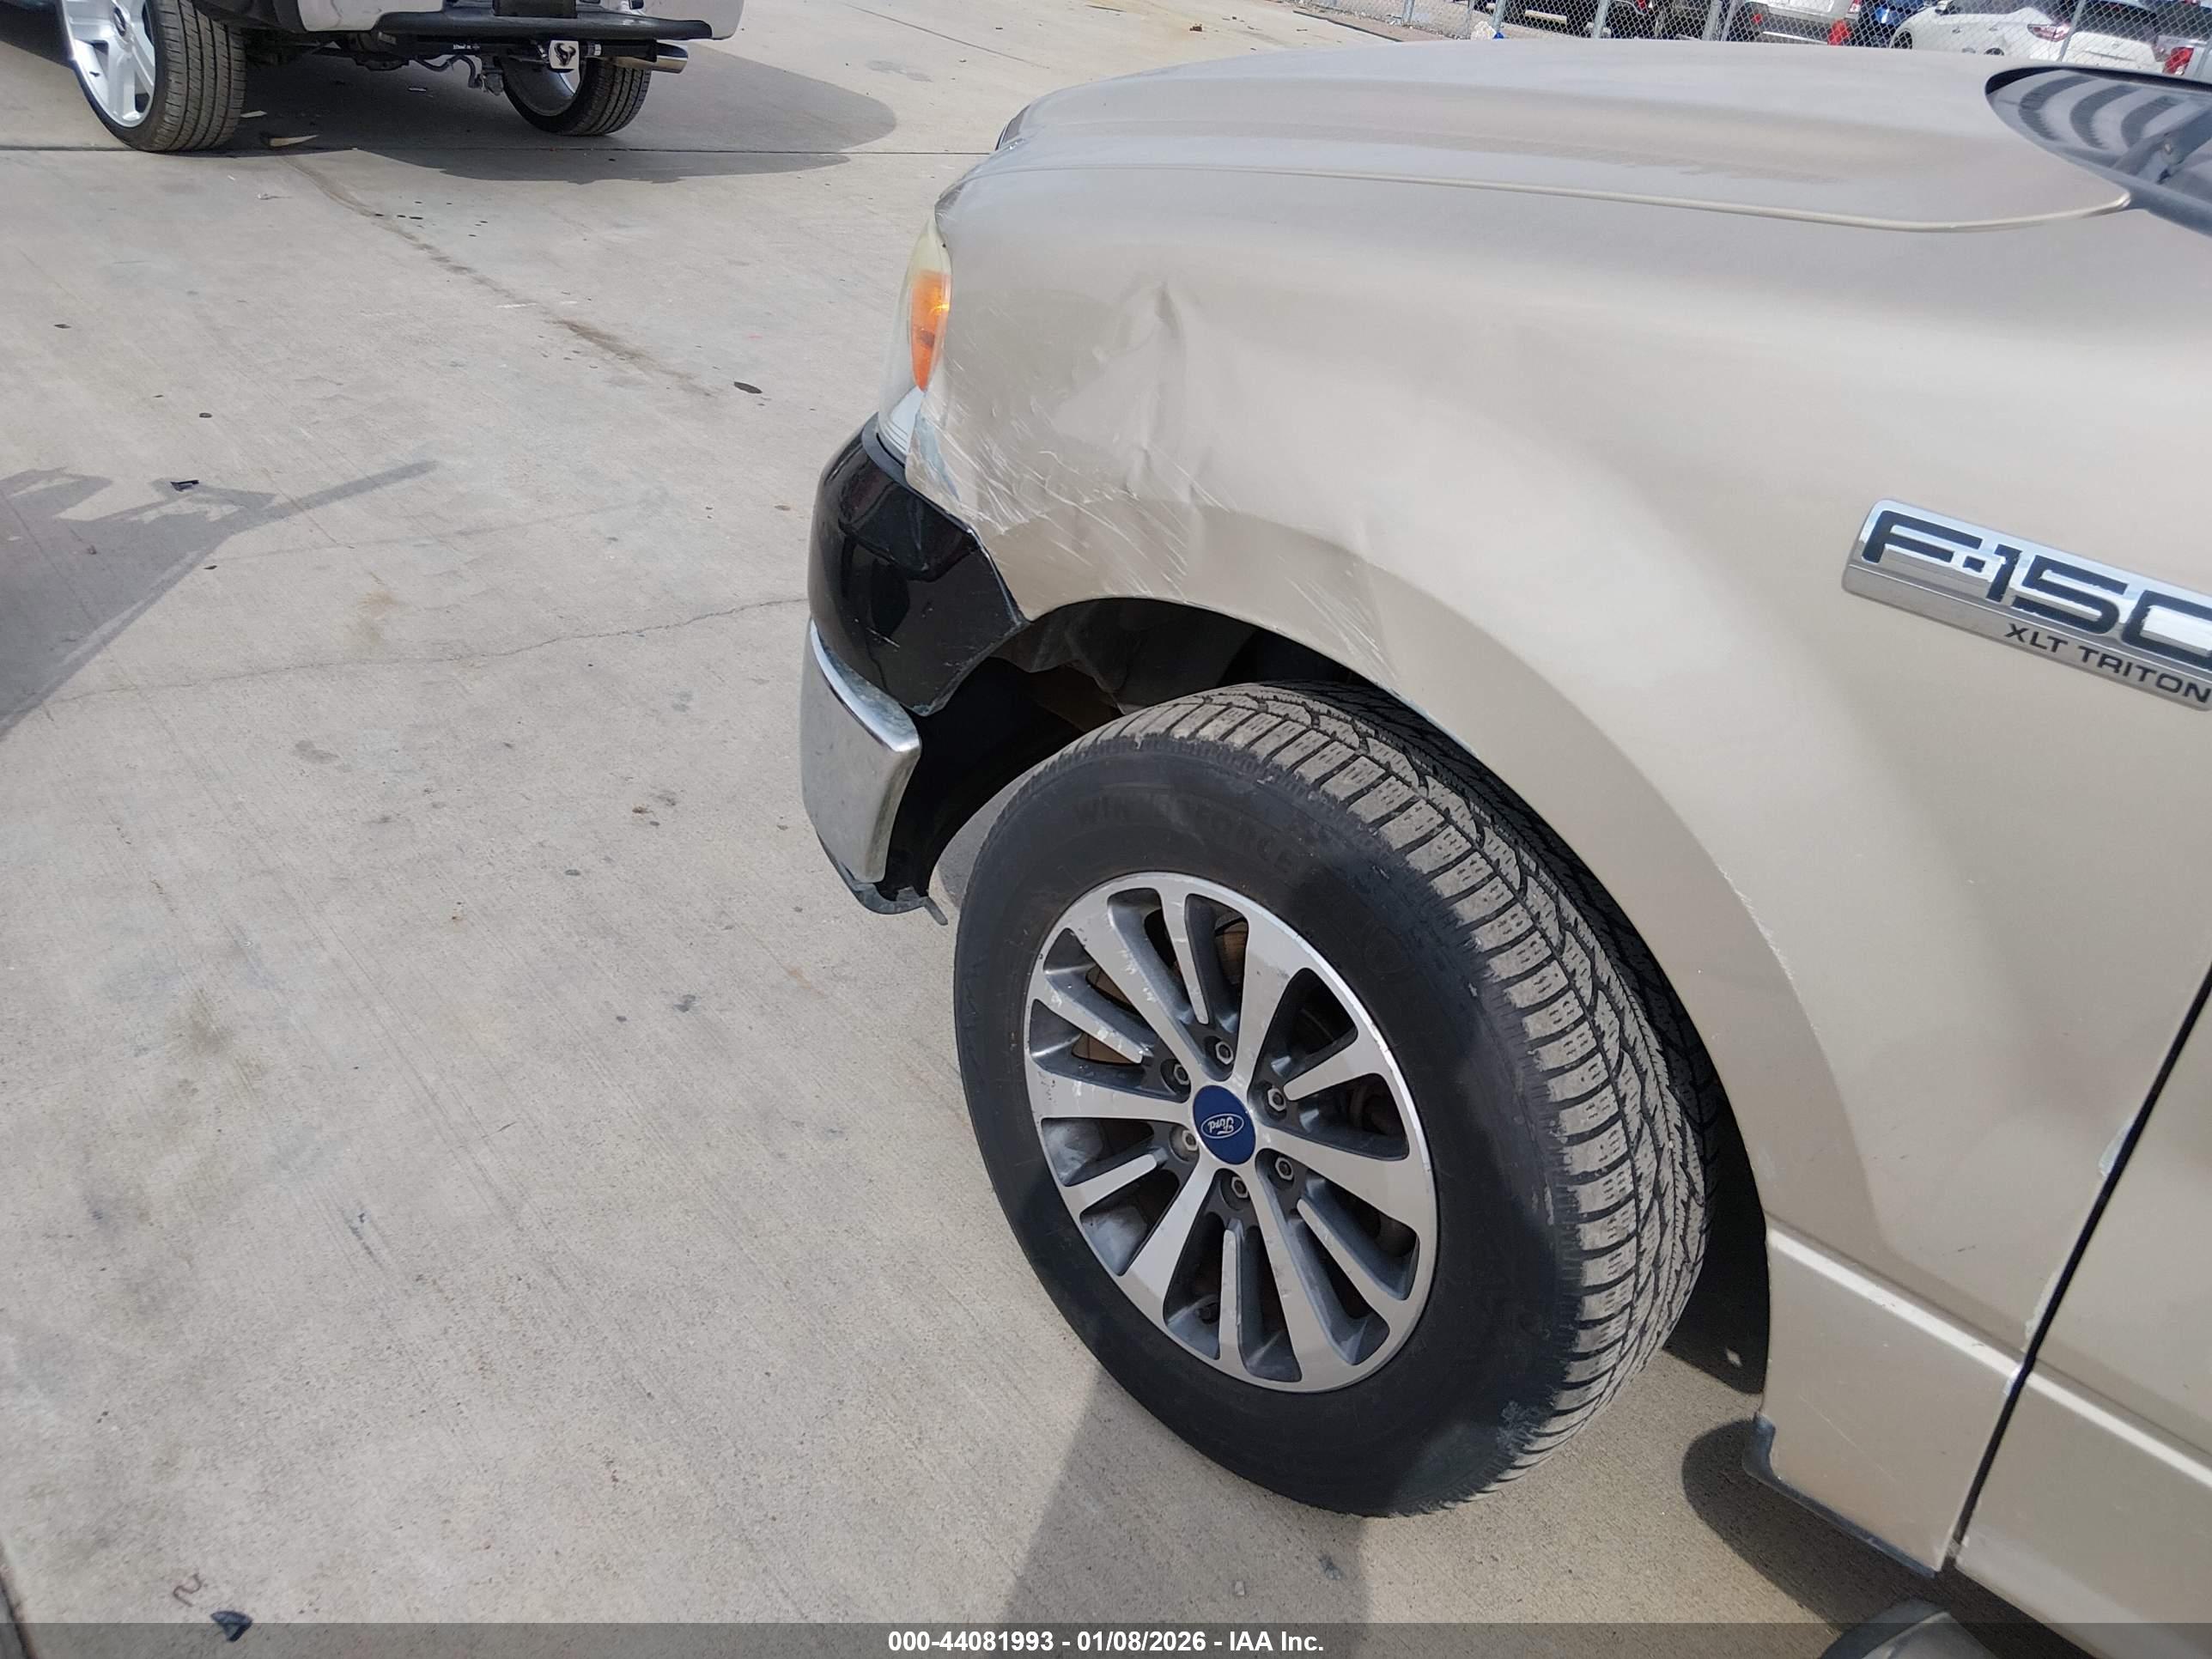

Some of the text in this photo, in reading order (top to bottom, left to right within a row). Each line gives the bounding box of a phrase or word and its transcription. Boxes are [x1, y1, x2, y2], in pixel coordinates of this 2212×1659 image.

[1862, 510, 2212, 671] F-150
[2004, 623, 2212, 703] XLT TRITON
[1206, 1116, 1234, 1135] Ford
